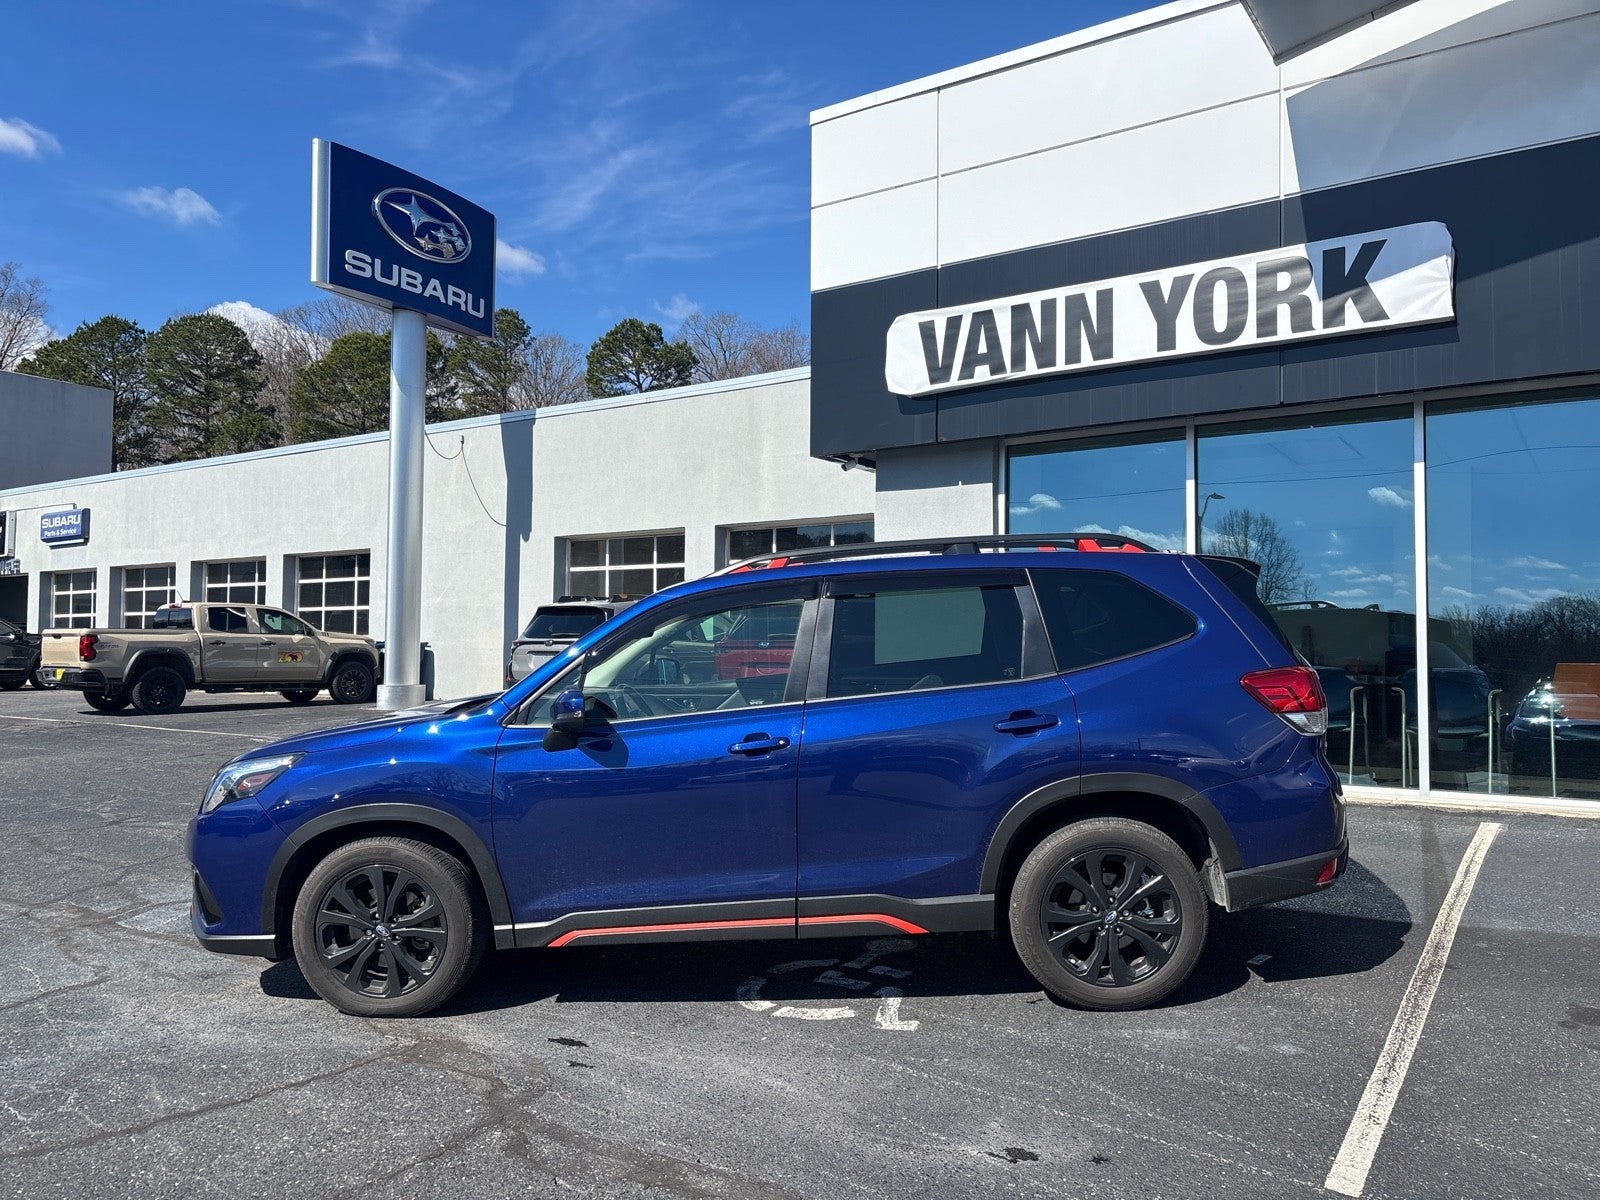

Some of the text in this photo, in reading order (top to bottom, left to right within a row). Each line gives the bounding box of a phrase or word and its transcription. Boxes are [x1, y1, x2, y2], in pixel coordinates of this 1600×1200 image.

[344, 249, 486, 319] SUBARU
[918, 239, 1391, 386] VANN YORK
[41, 514, 81, 529] SUBARU
